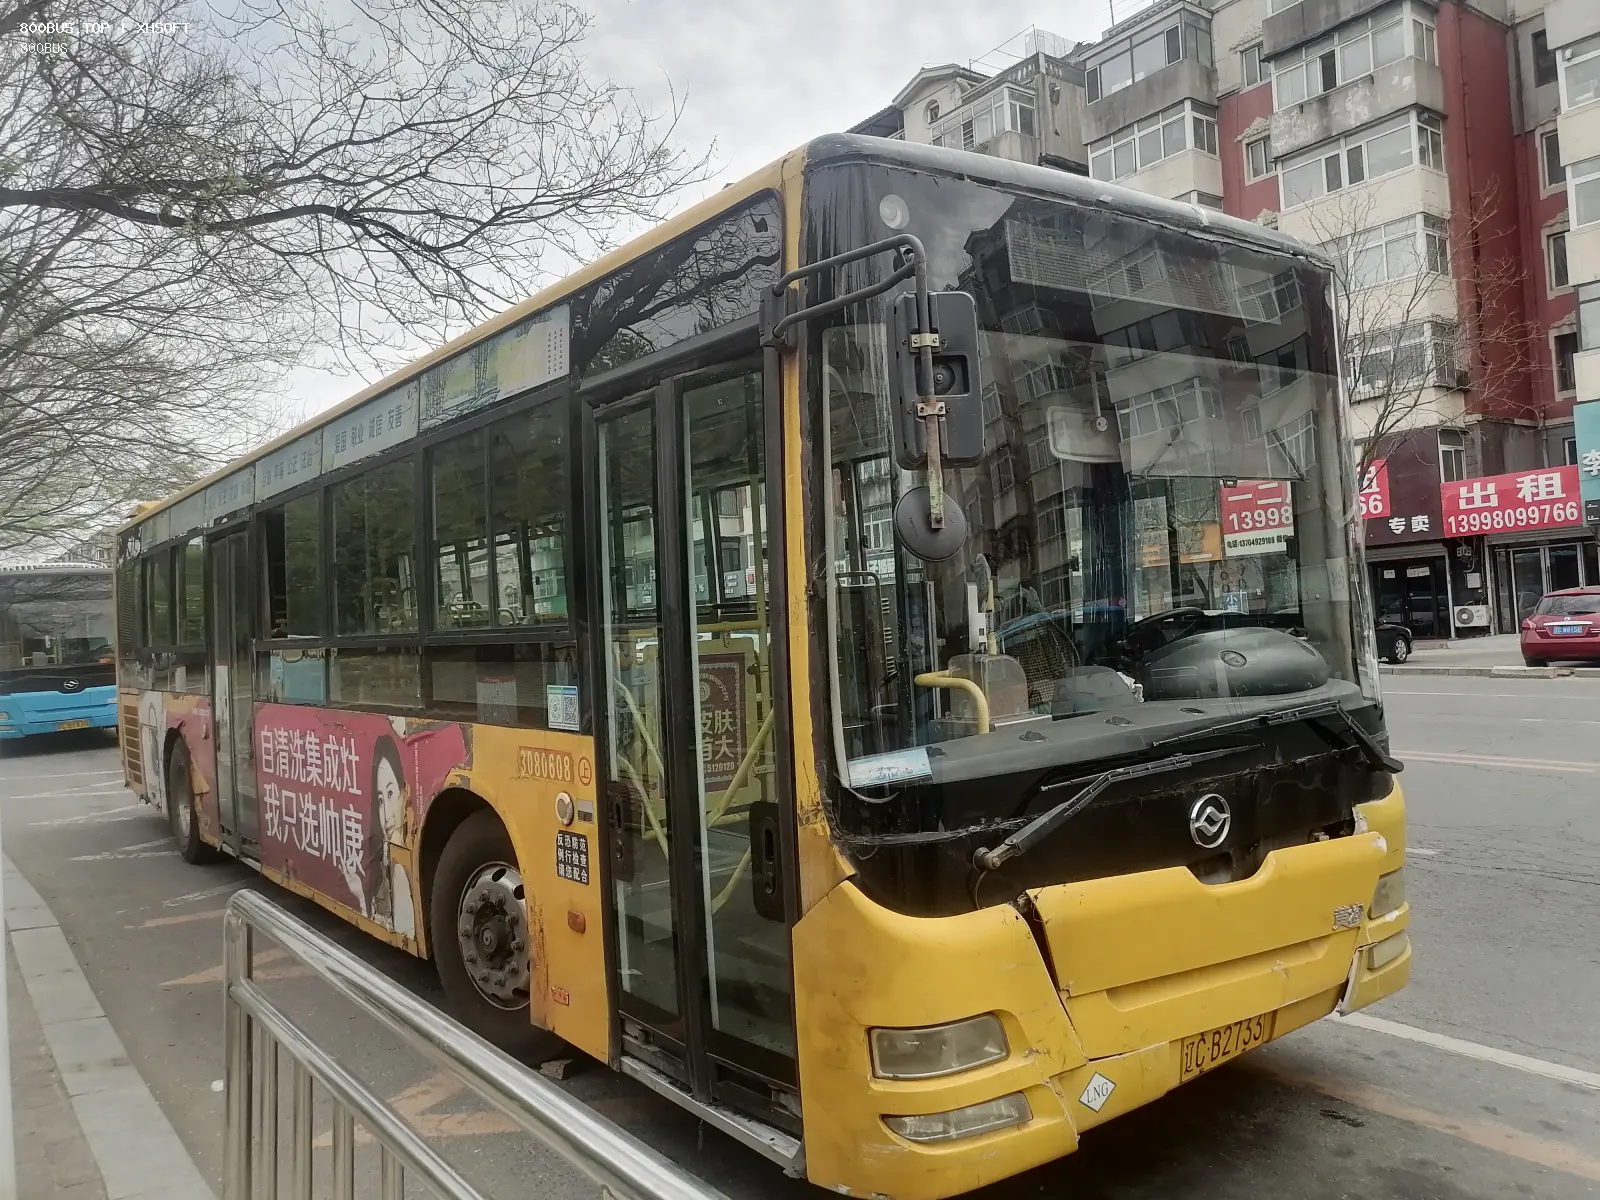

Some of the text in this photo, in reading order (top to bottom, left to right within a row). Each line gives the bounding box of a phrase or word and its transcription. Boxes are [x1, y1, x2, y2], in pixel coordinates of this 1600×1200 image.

[387, 404, 402, 431] 友善
[1458, 472, 1566, 510] 出租
[1229, 505, 1293, 531] 13998
[1388, 515, 1430, 535] 专卖
[1447, 501, 1578, 534] 13998099766
[260, 724, 362, 796] 自清洗集成灶
[520, 749, 571, 781] 3080608
[263, 782, 366, 877] 我只选帅康
[557, 833, 587, 851] 反恐防范
[557, 848, 587, 867] 例行检查
[558, 863, 588, 883] 请您配合
[1085, 1081, 1109, 1104] LNG
